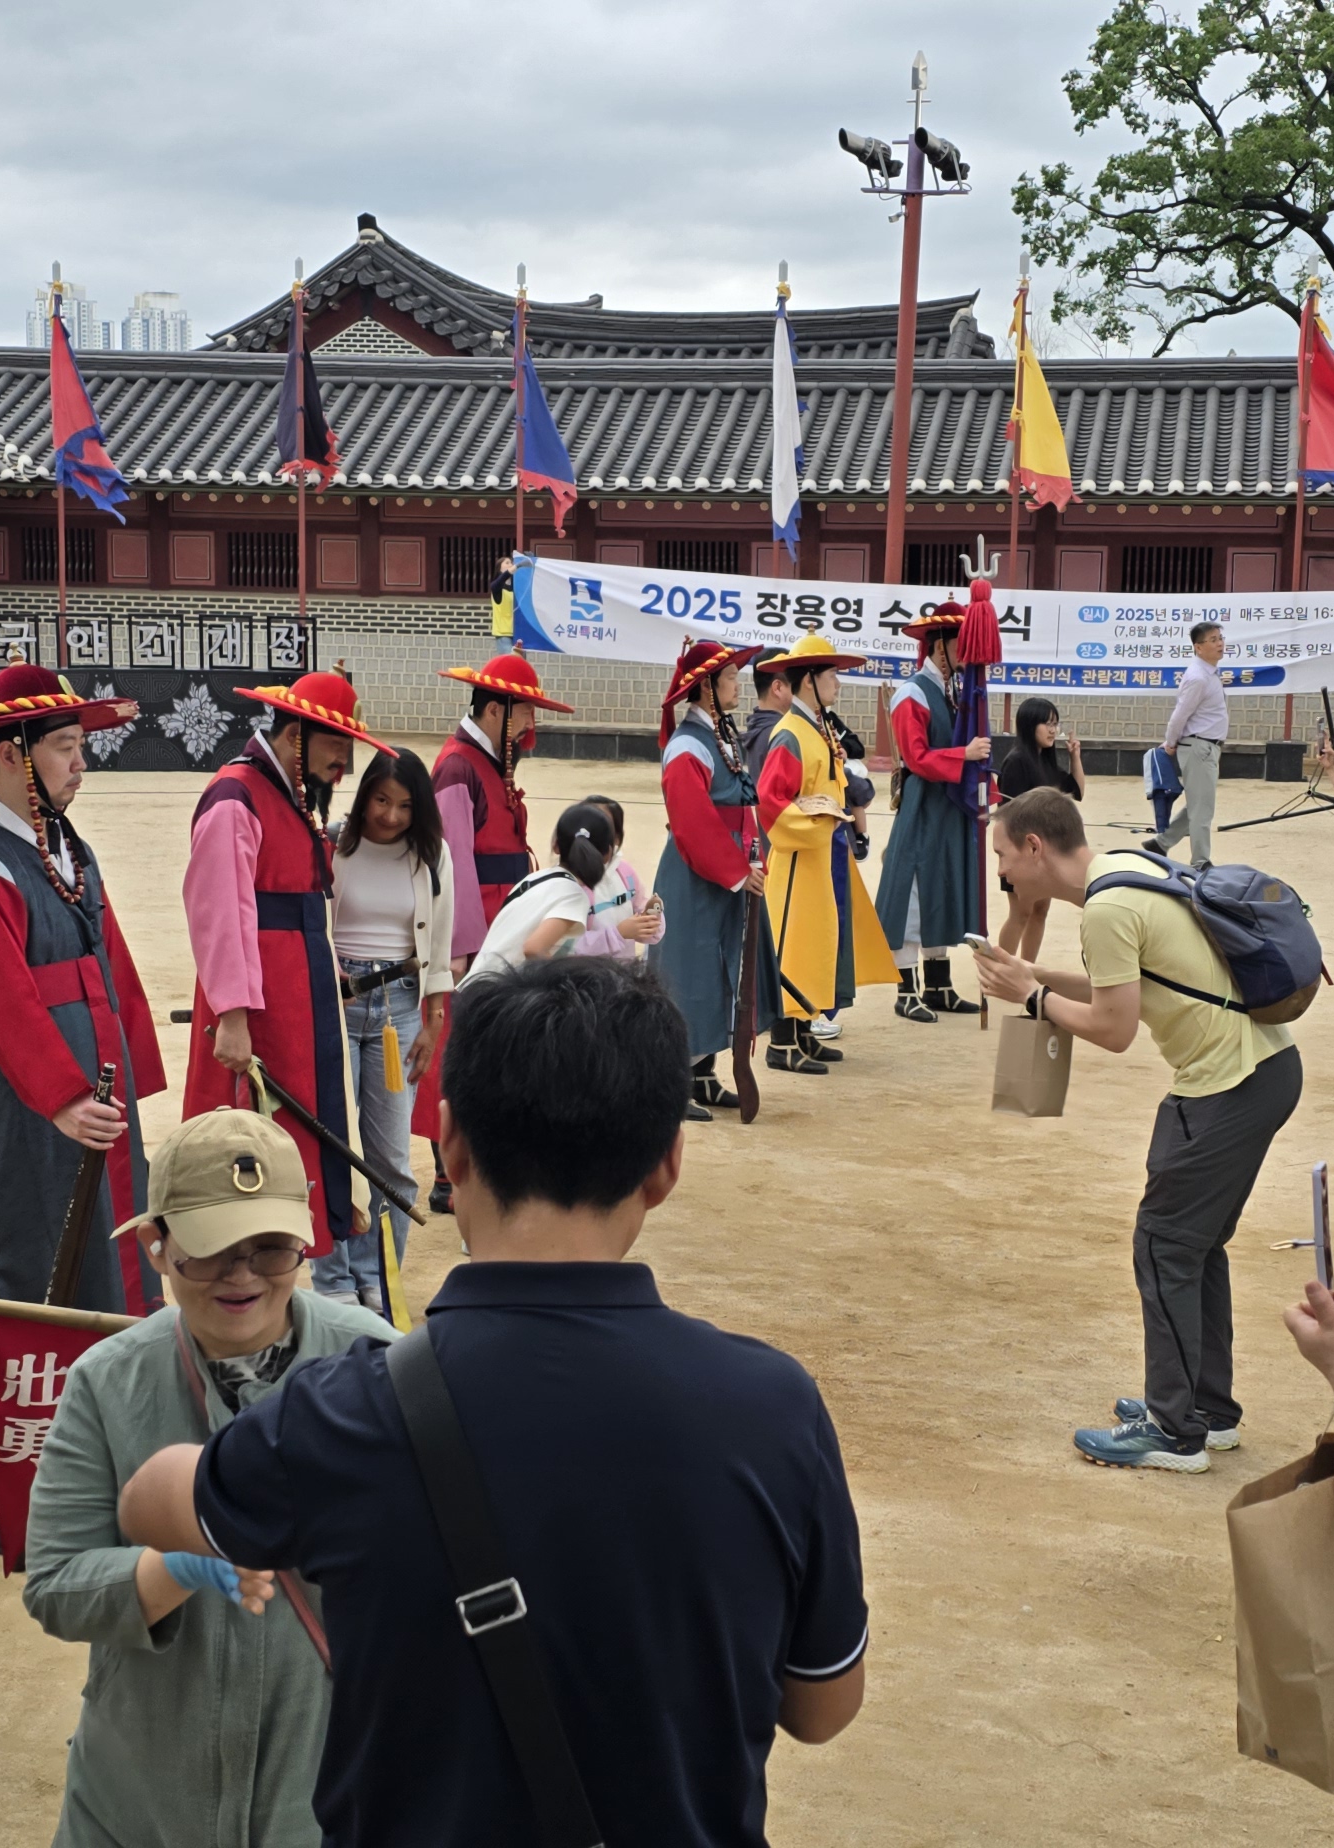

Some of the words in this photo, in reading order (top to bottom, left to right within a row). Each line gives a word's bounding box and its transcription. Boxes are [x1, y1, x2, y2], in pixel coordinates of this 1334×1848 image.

[640, 583, 742, 624] 2025
[755, 592, 864, 632] 장용영
[878, 600, 1032, 642] 수식
[1081, 608, 1106, 621] 일시
[1115, 607, 1167, 622] 2025년
[1171, 608, 1232, 622] 5월~10월
[1239, 607, 1266, 622] 매주
[1269, 606, 1308, 621] 토요일
[553, 623, 617, 642] 수원특례시
[721, 626, 802, 644] JangYongYe
[872, 637, 921, 651] Cerem
[1114, 625, 1147, 639] (7,8월
[1150, 625, 1185, 639] 혹서기
[1079, 643, 1105, 657] 장소
[1113, 643, 1165, 658] 화성행궁
[1245, 643, 1258, 658] 및
[1262, 643, 1302, 658] 행궁동
[1306, 642, 1333, 657] 일원
[1011, 666, 1077, 686] 수위의식,
[1081, 669, 1128, 686] 관람객
[1132, 669, 1168, 686] 체험,
[1240, 668, 1255, 684] 등
